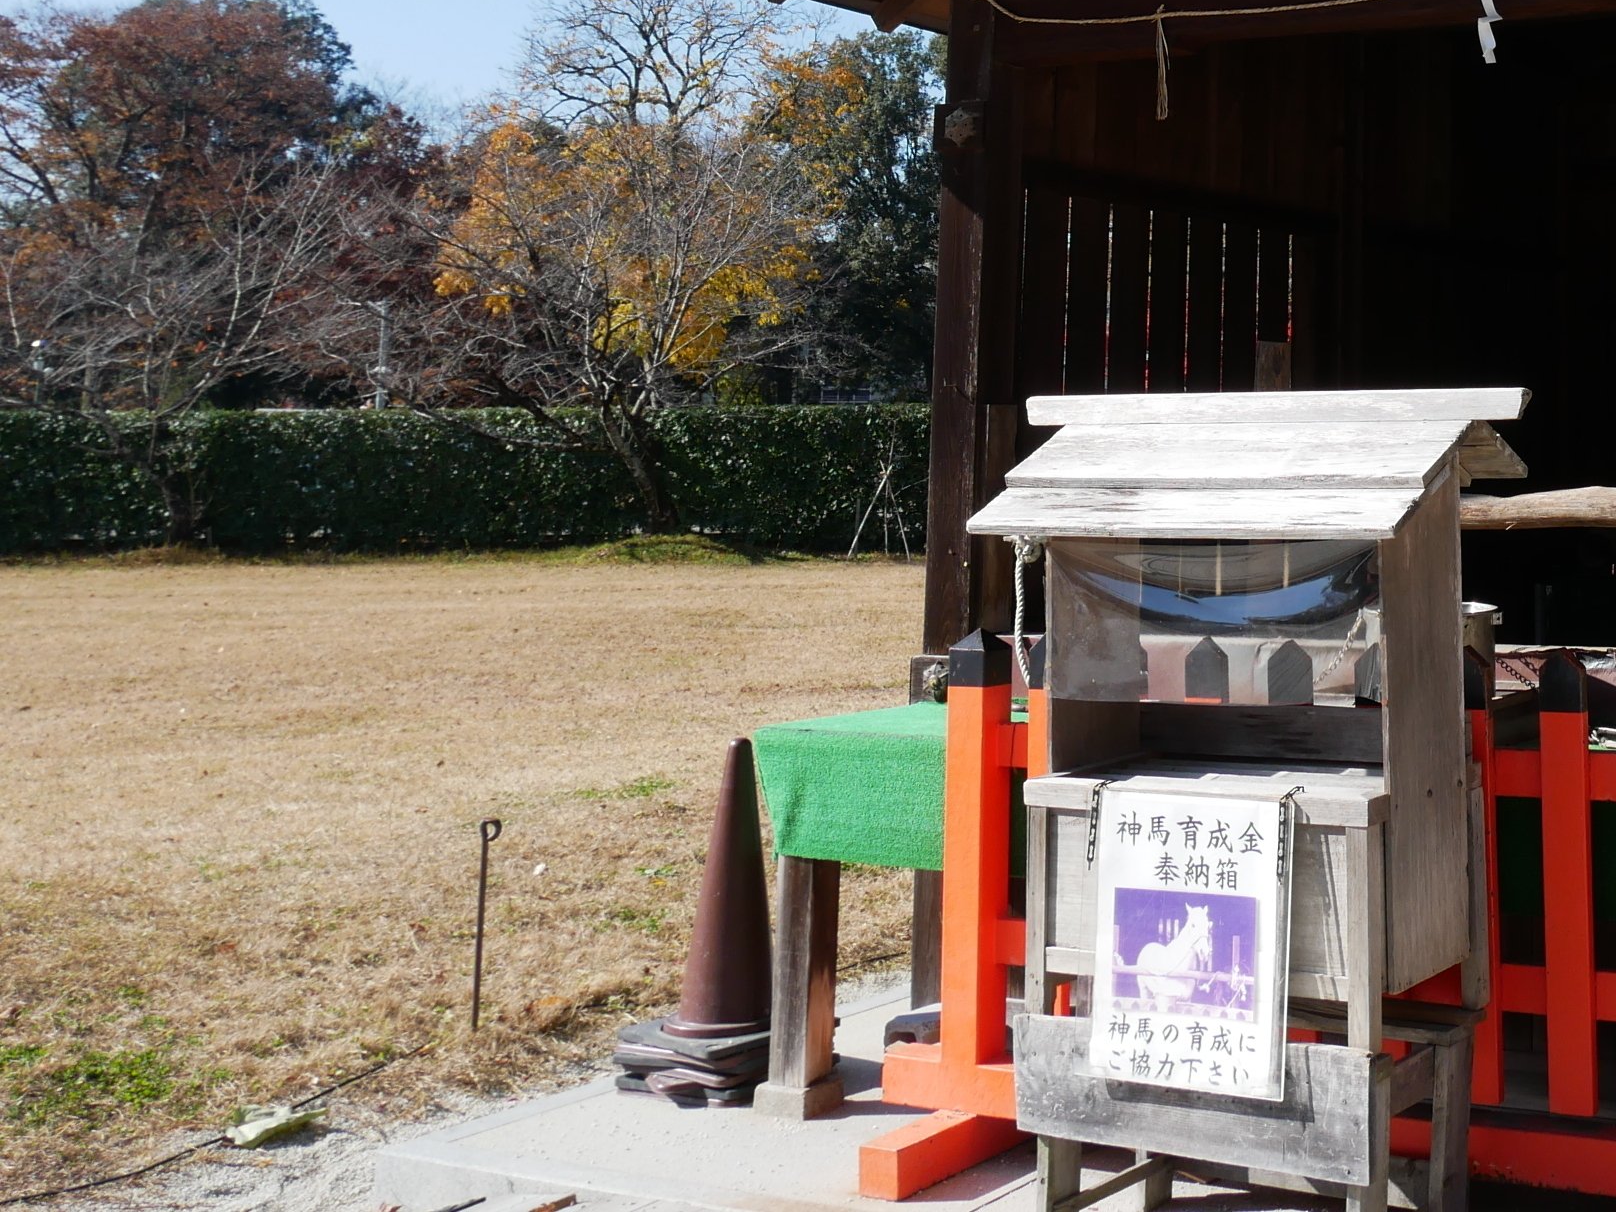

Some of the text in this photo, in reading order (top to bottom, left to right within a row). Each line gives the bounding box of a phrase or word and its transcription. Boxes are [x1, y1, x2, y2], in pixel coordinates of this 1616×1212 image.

[1116, 811, 1264, 855] 神馬育成金
[1154, 851, 1238, 891] 奉納箱
[1108, 1013, 1256, 1057] 神馬の育成に
[1108, 1049, 1249, 1087] ご協力下さい
